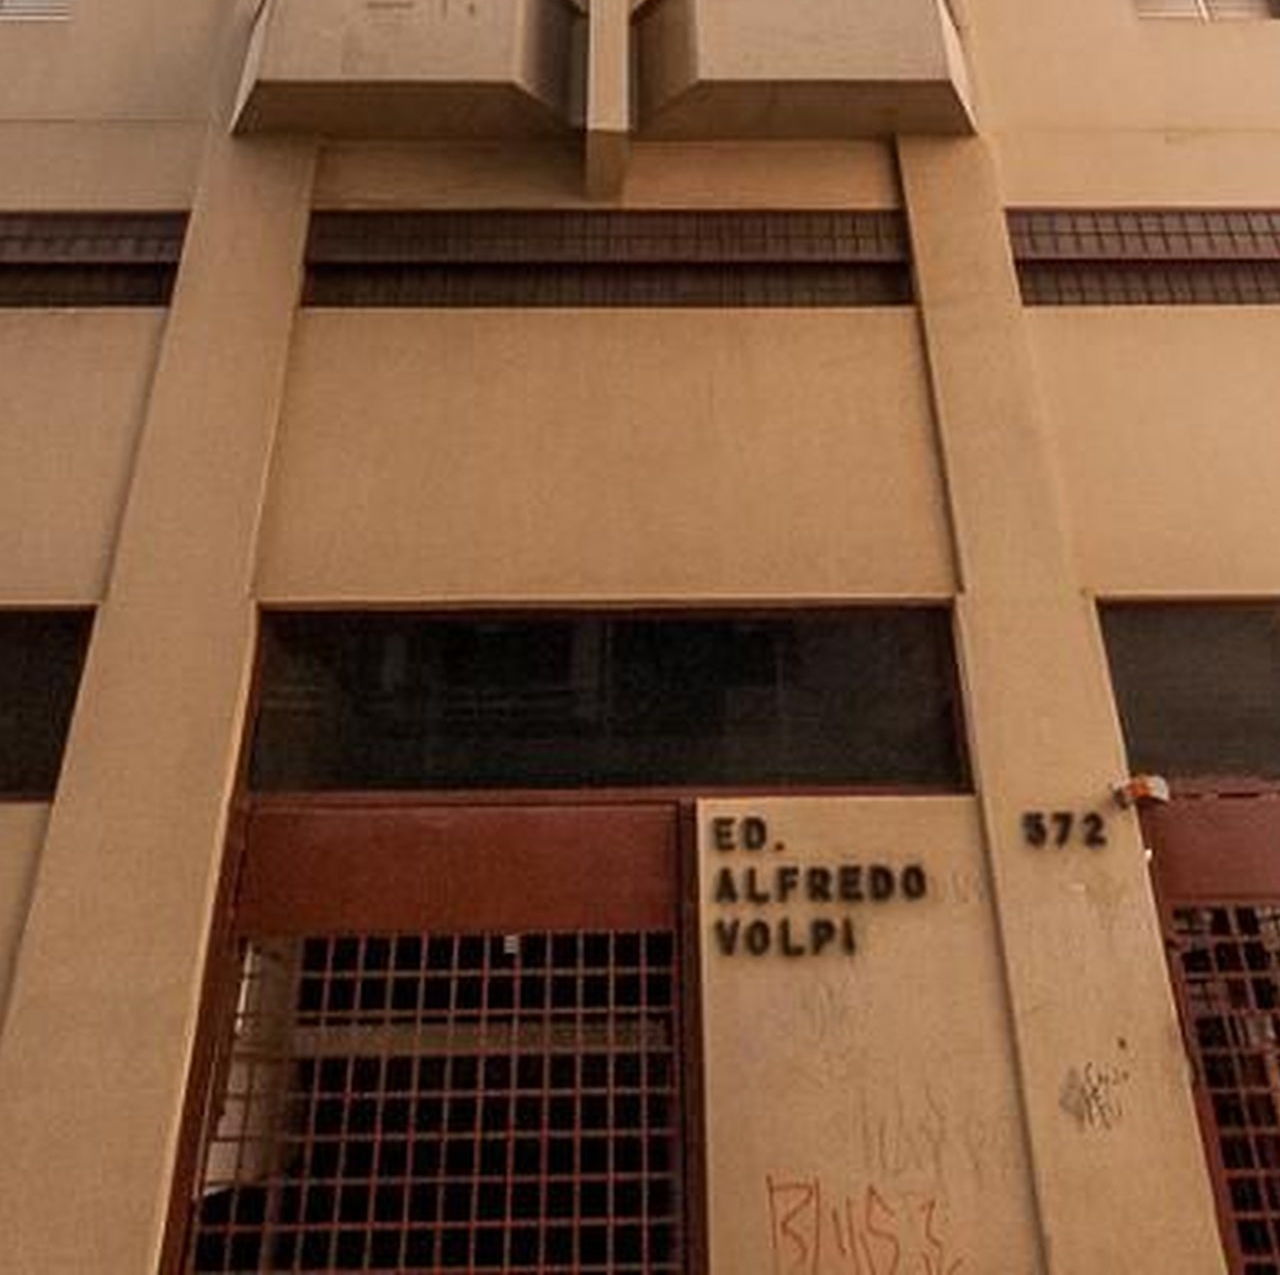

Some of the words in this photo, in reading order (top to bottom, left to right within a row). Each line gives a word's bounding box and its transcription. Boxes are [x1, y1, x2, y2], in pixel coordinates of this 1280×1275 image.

[711, 817, 785, 851] ED.
[1021, 811, 1107, 848] 572
[714, 865, 928, 904] ALFREDO
[714, 918, 857, 958] VOLPI
